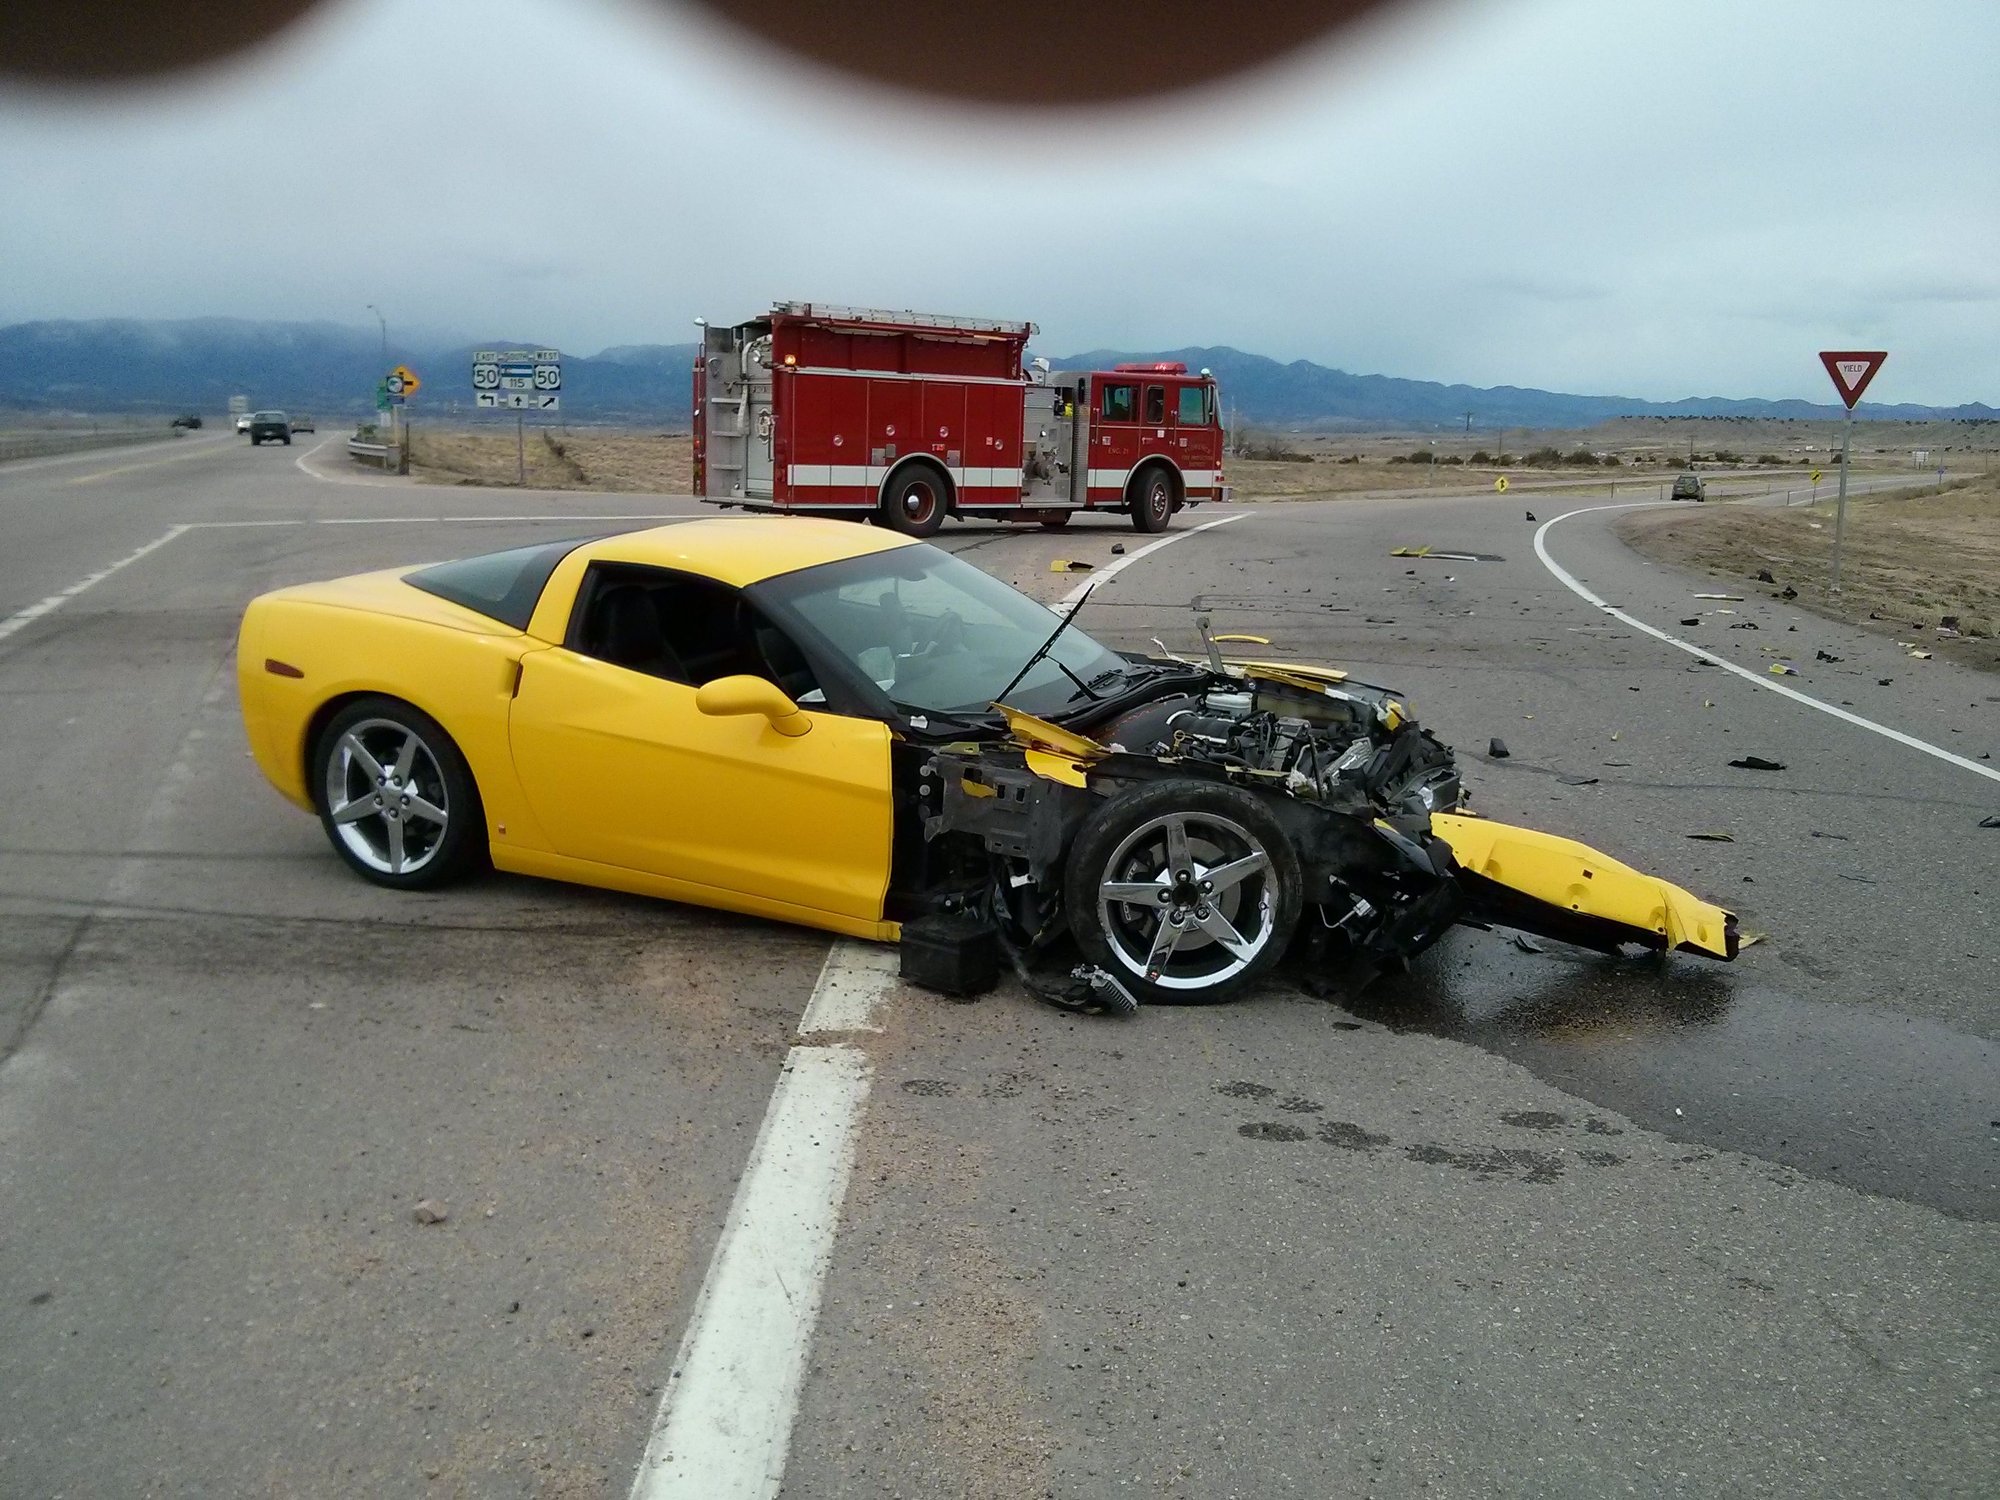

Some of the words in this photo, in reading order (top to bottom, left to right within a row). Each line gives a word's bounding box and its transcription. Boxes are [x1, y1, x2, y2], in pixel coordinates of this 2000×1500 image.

[475, 352, 494, 361] EAST
[537, 351, 557, 360] WEST
[1844, 364, 1862, 372] YIELD
[476, 370, 496, 384] 50
[537, 371, 557, 385] 50
[510, 378, 525, 388] 115
